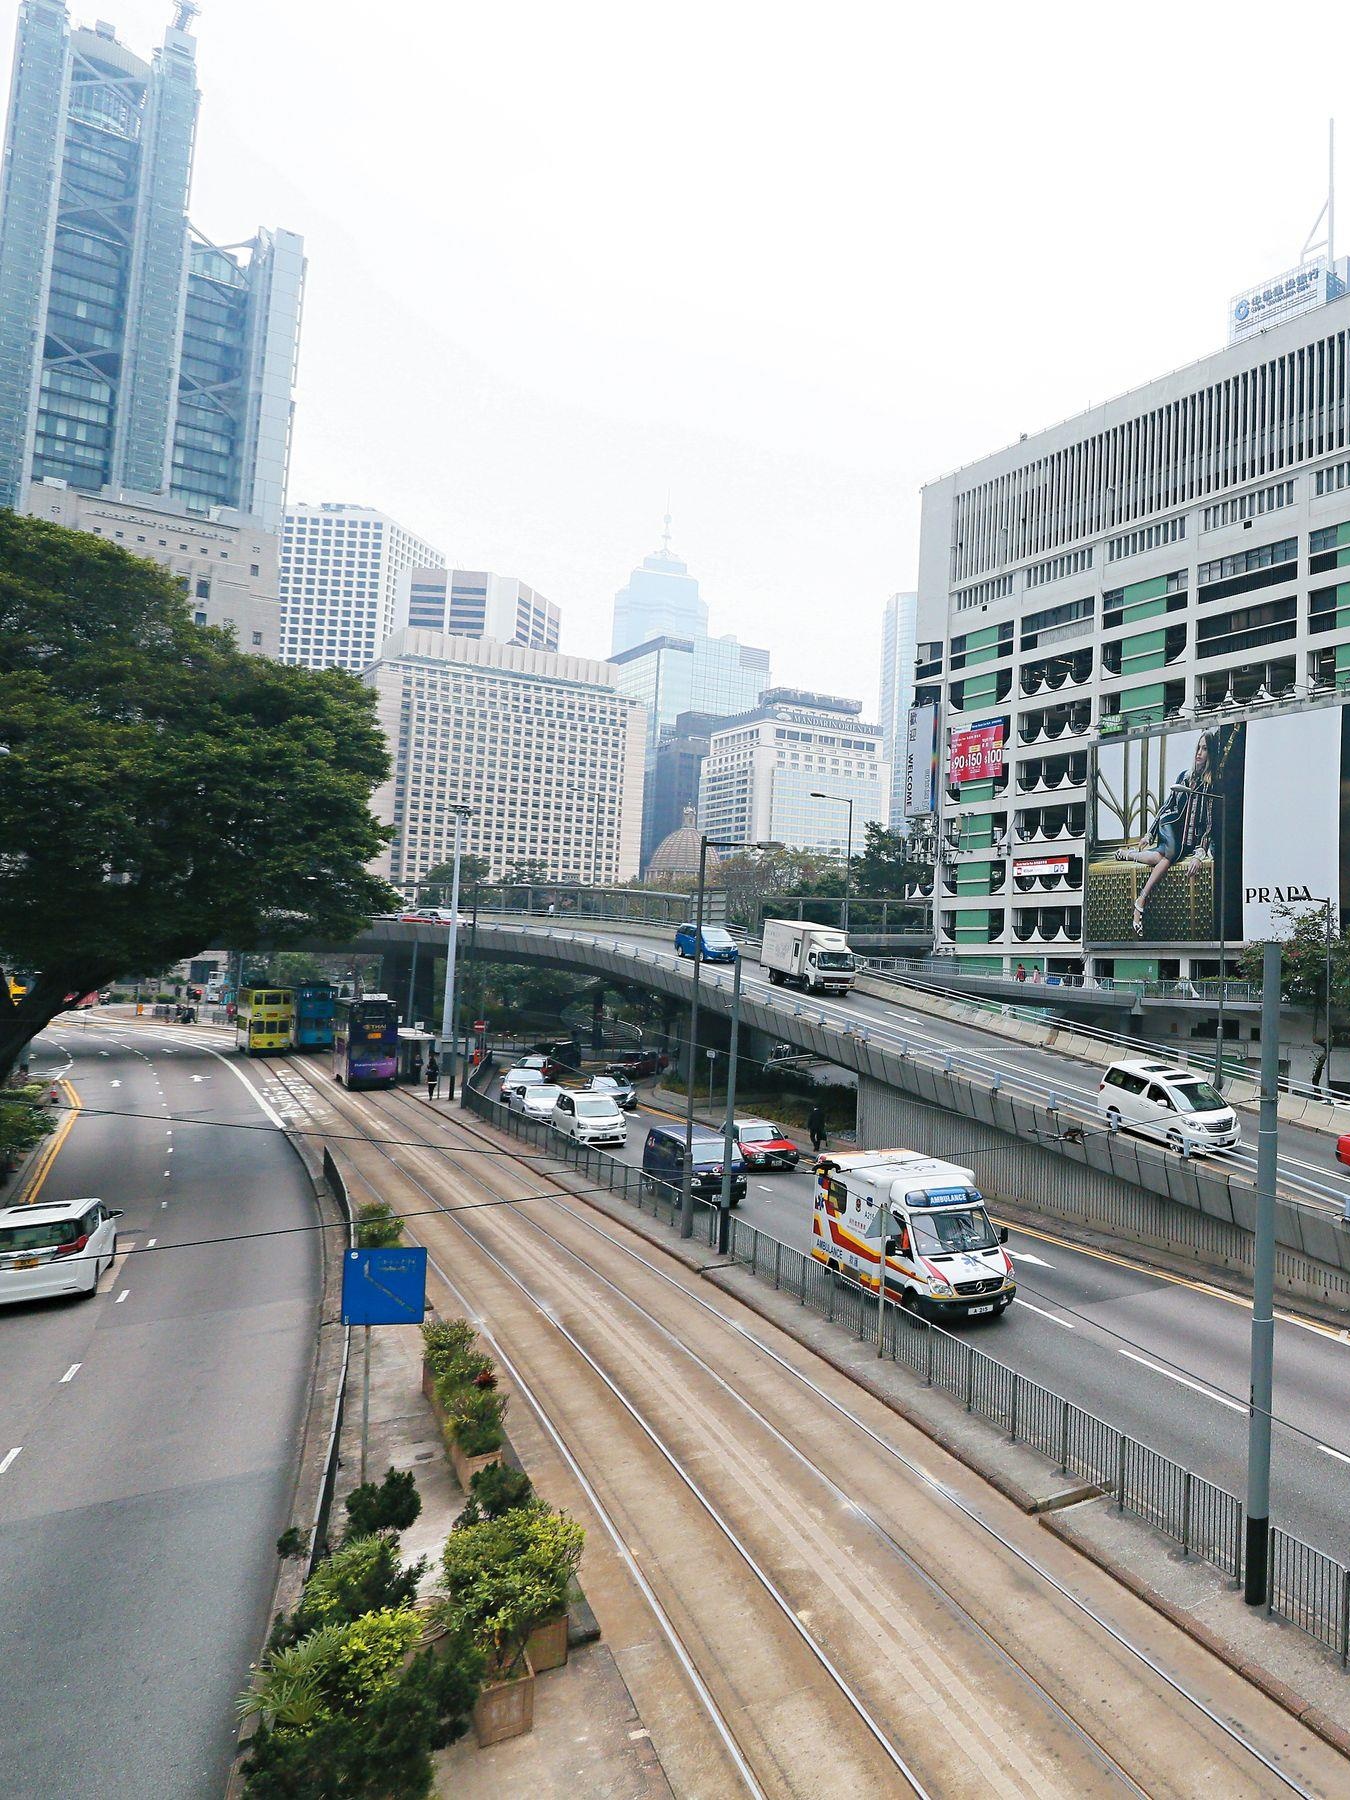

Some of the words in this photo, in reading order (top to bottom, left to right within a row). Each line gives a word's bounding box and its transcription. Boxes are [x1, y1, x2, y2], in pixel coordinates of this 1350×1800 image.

[793, 715, 838, 728] MANDARIN
[839, 722, 876, 735] ORIENTAL
[951, 755, 965, 769] $90
[965, 752, 982, 768] $150
[984, 749, 1001, 764] $100
[1245, 886, 1312, 903] PRADA
[930, 1193, 967, 1204] AMBULANCE
[816, 1239, 843, 1259] AMBULANCE
